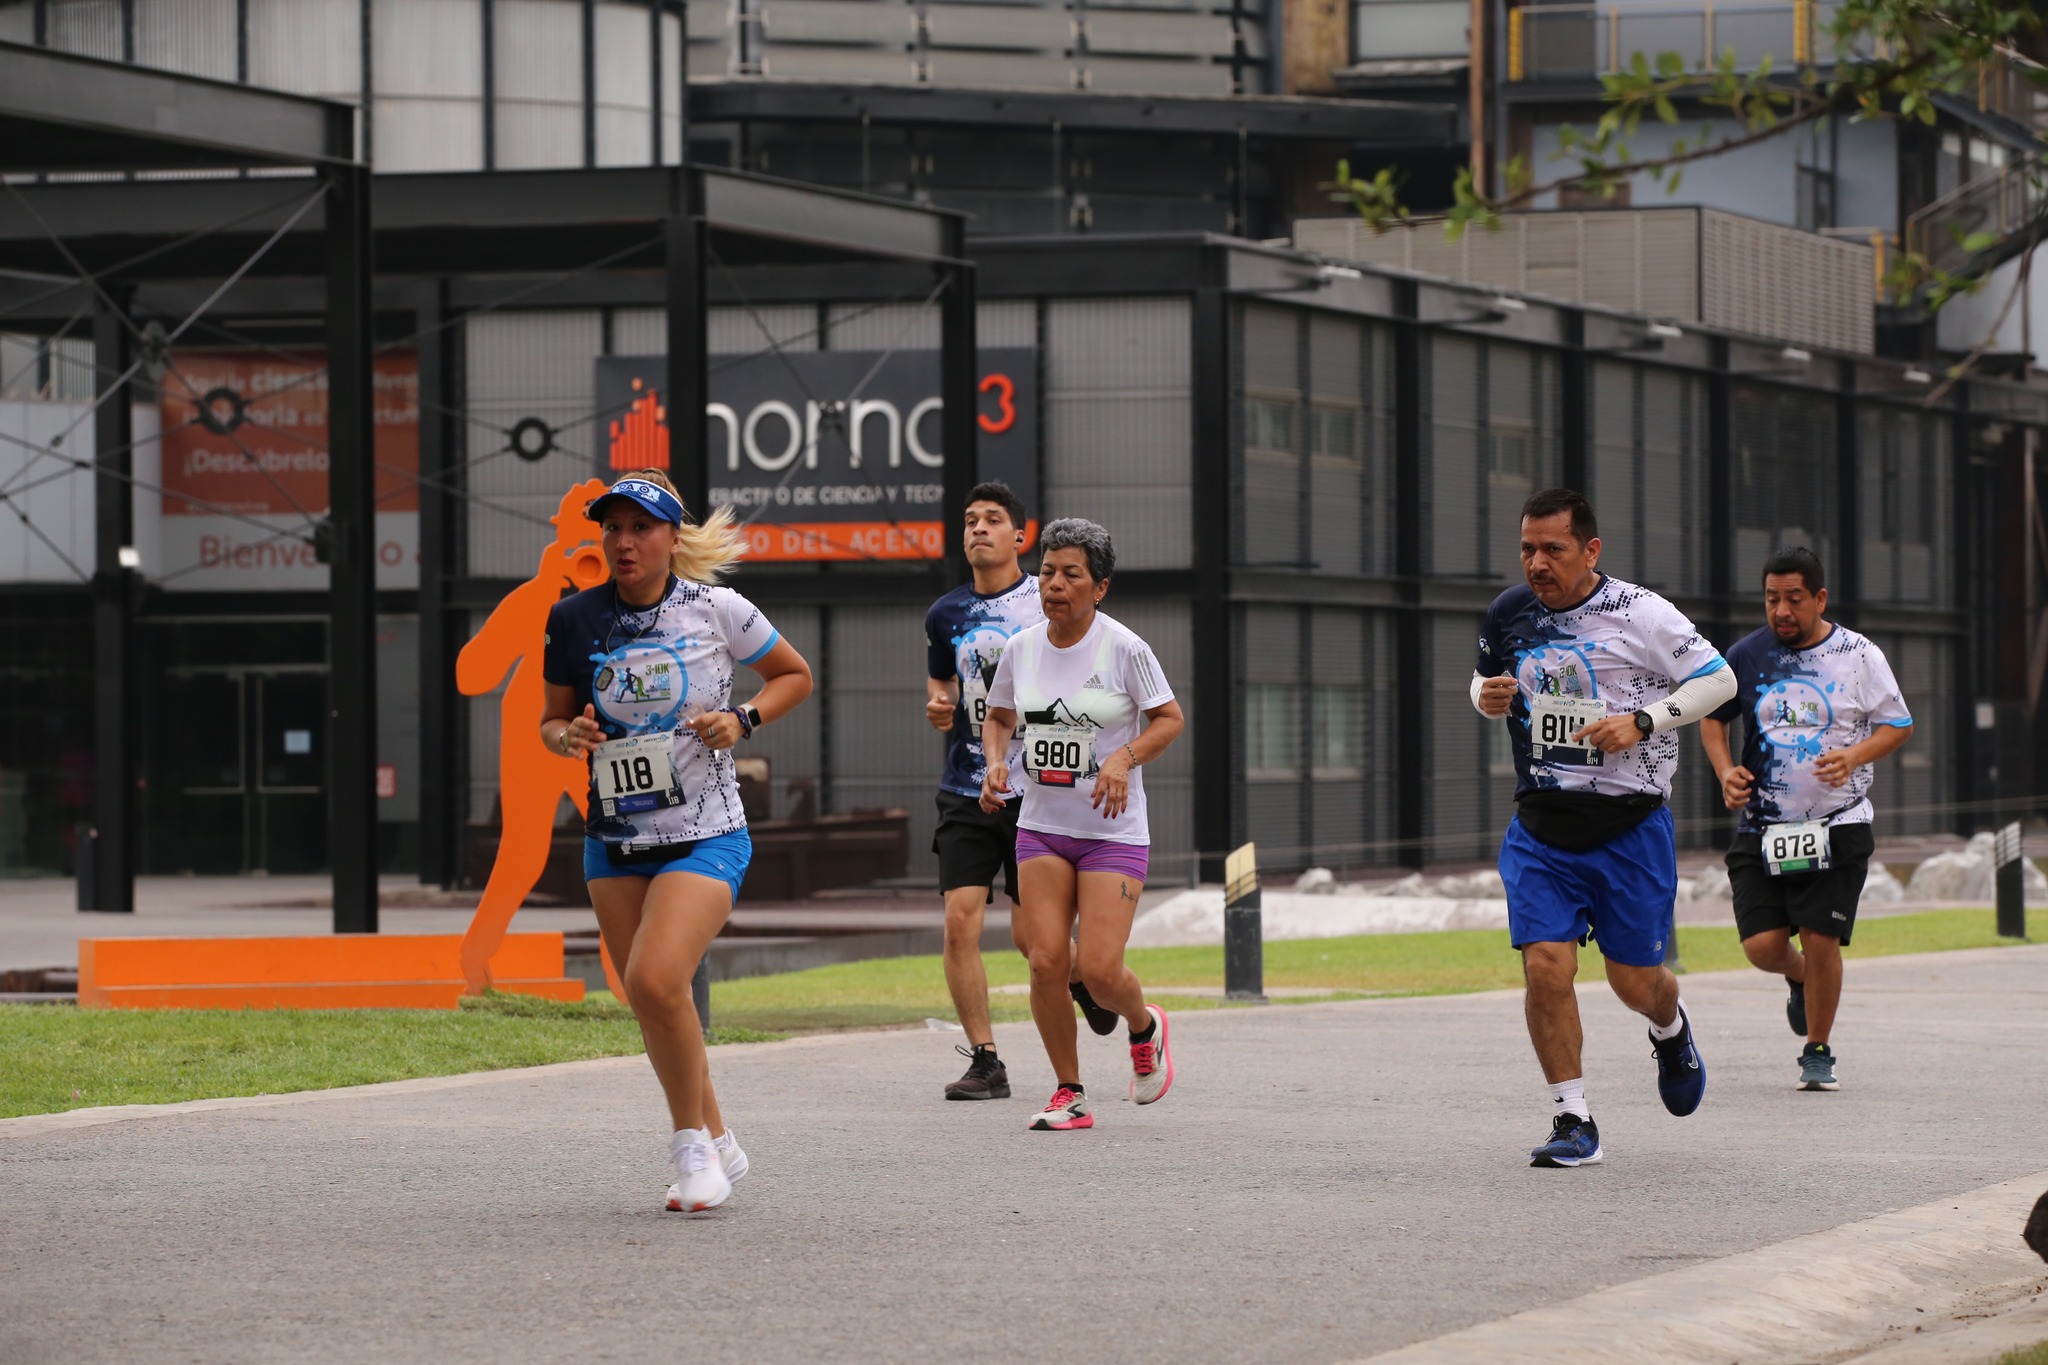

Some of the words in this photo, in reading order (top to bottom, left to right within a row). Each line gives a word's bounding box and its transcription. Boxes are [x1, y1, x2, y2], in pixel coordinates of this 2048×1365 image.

[793, 485, 817, 505] DE
[783, 530, 835, 554] DEL
[849, 528, 942, 554] ACERO
[645, 662, 670, 676] 3-10K
[1034, 740, 1080, 769] 980
[1586, 757, 1598, 765] 814
[610, 756, 654, 794] 118
[668, 796, 680, 805] 118
[1773, 833, 1817, 860] 872
